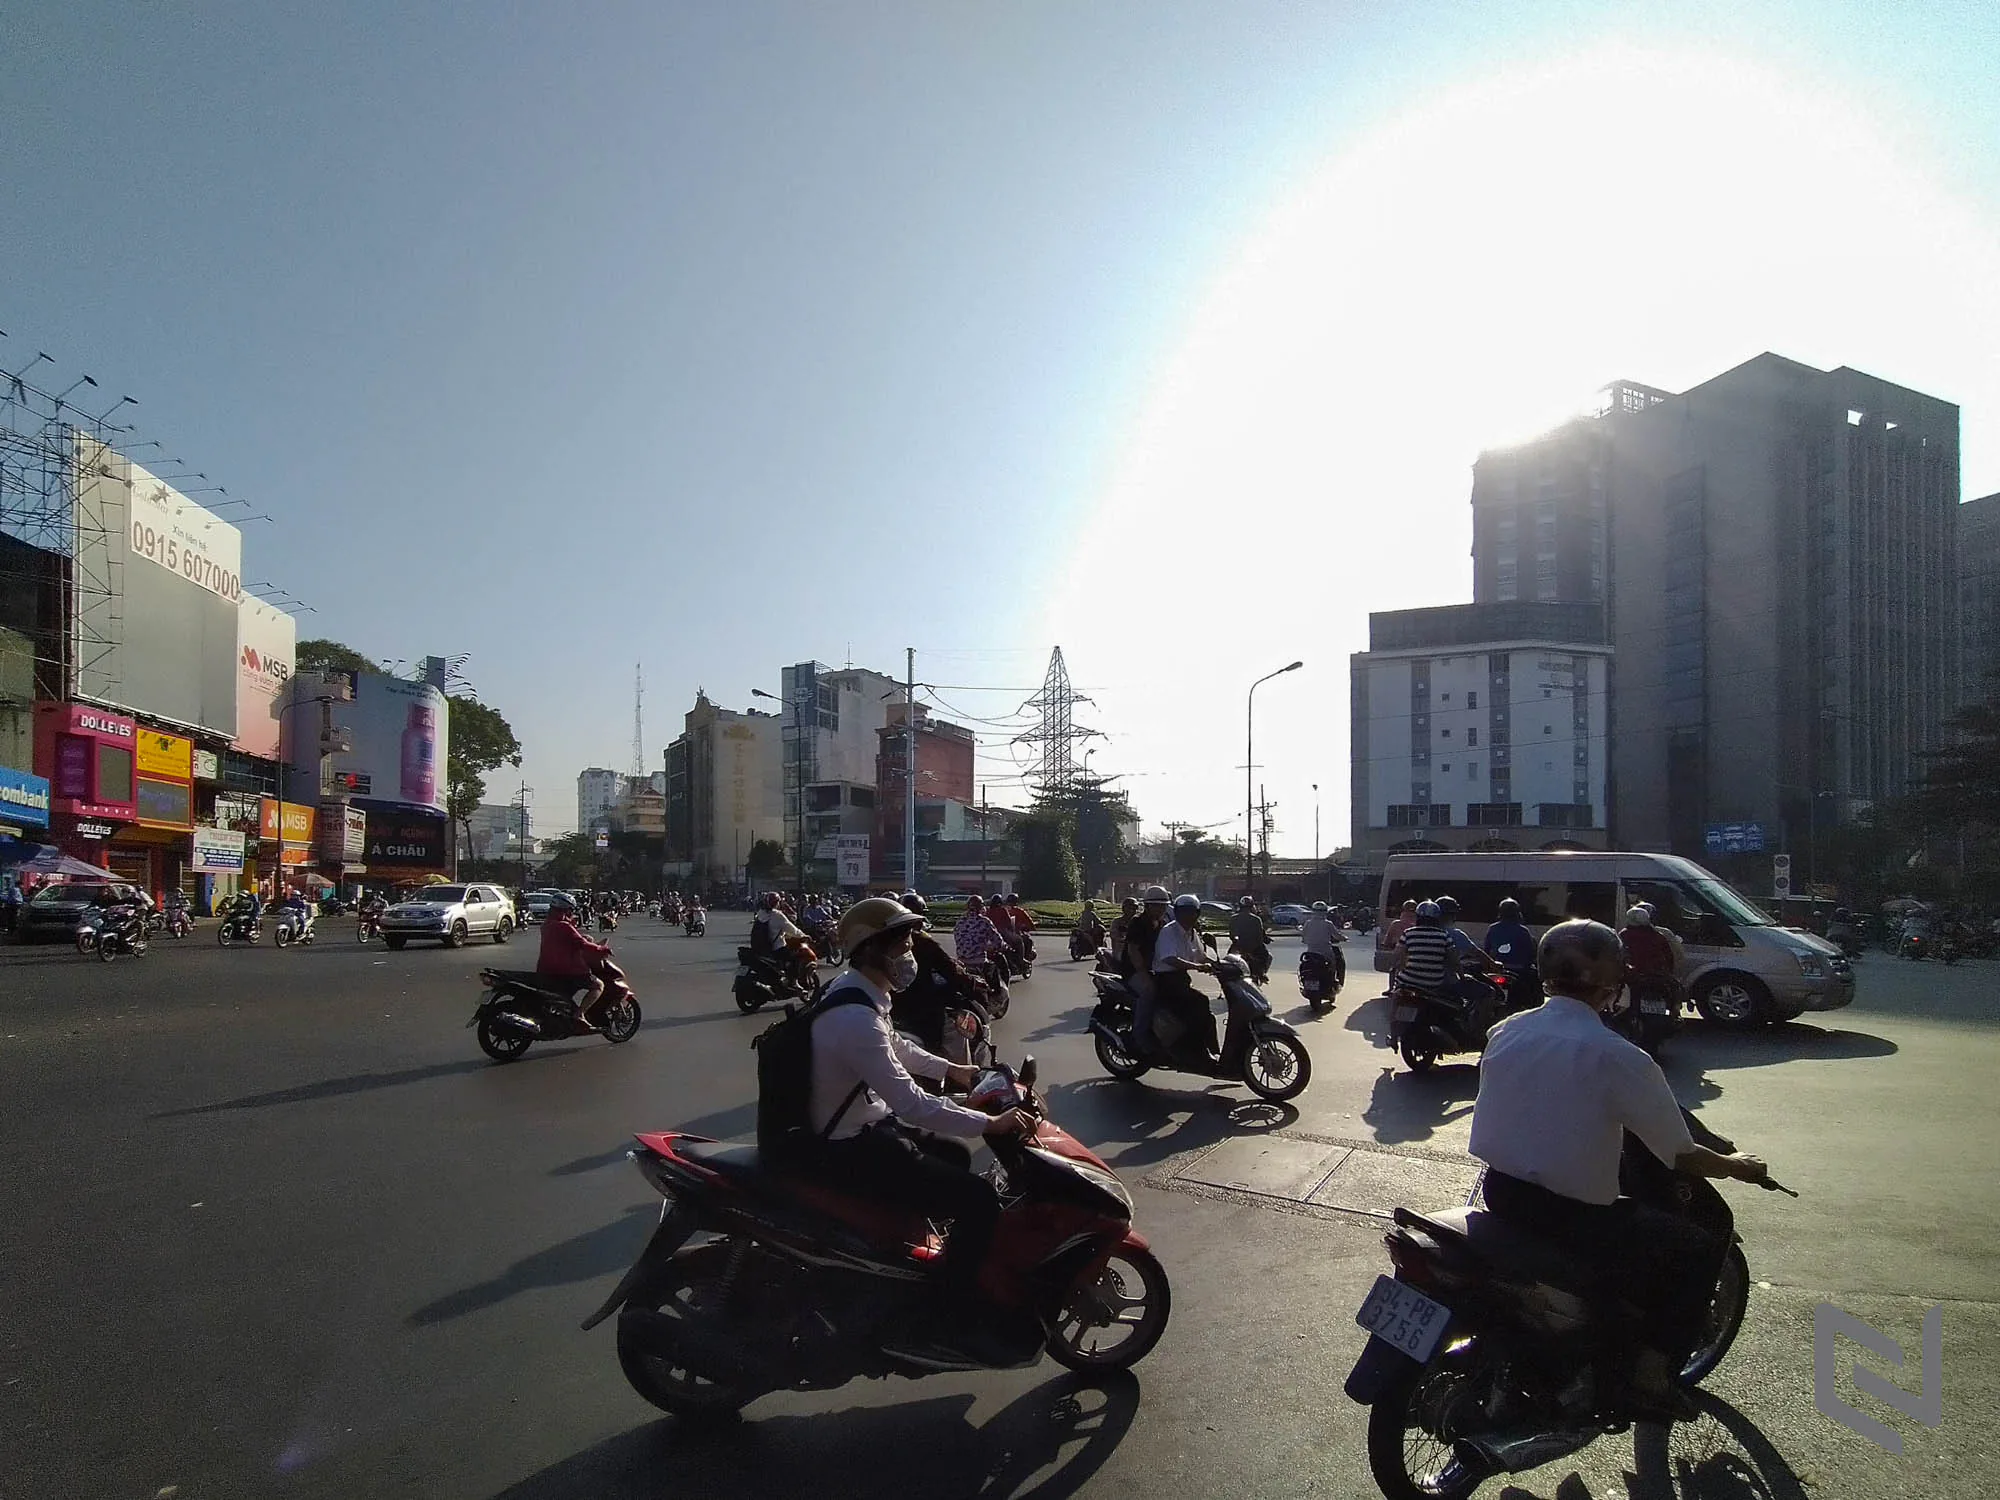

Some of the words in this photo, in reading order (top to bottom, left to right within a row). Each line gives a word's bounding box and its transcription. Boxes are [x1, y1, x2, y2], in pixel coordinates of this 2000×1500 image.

[133, 520, 177, 570] 0915
[183, 549, 240, 601] 607000
[263, 655, 288, 681] MSB
[81, 714, 131, 737] DOLLEYES
[0, 783, 48, 810] ombank
[76, 822, 113, 835] DOLLEYES
[286, 813, 308, 831] MSB
[846, 861, 859, 876] 79
[1366, 1304, 1425, 1350] 3756
